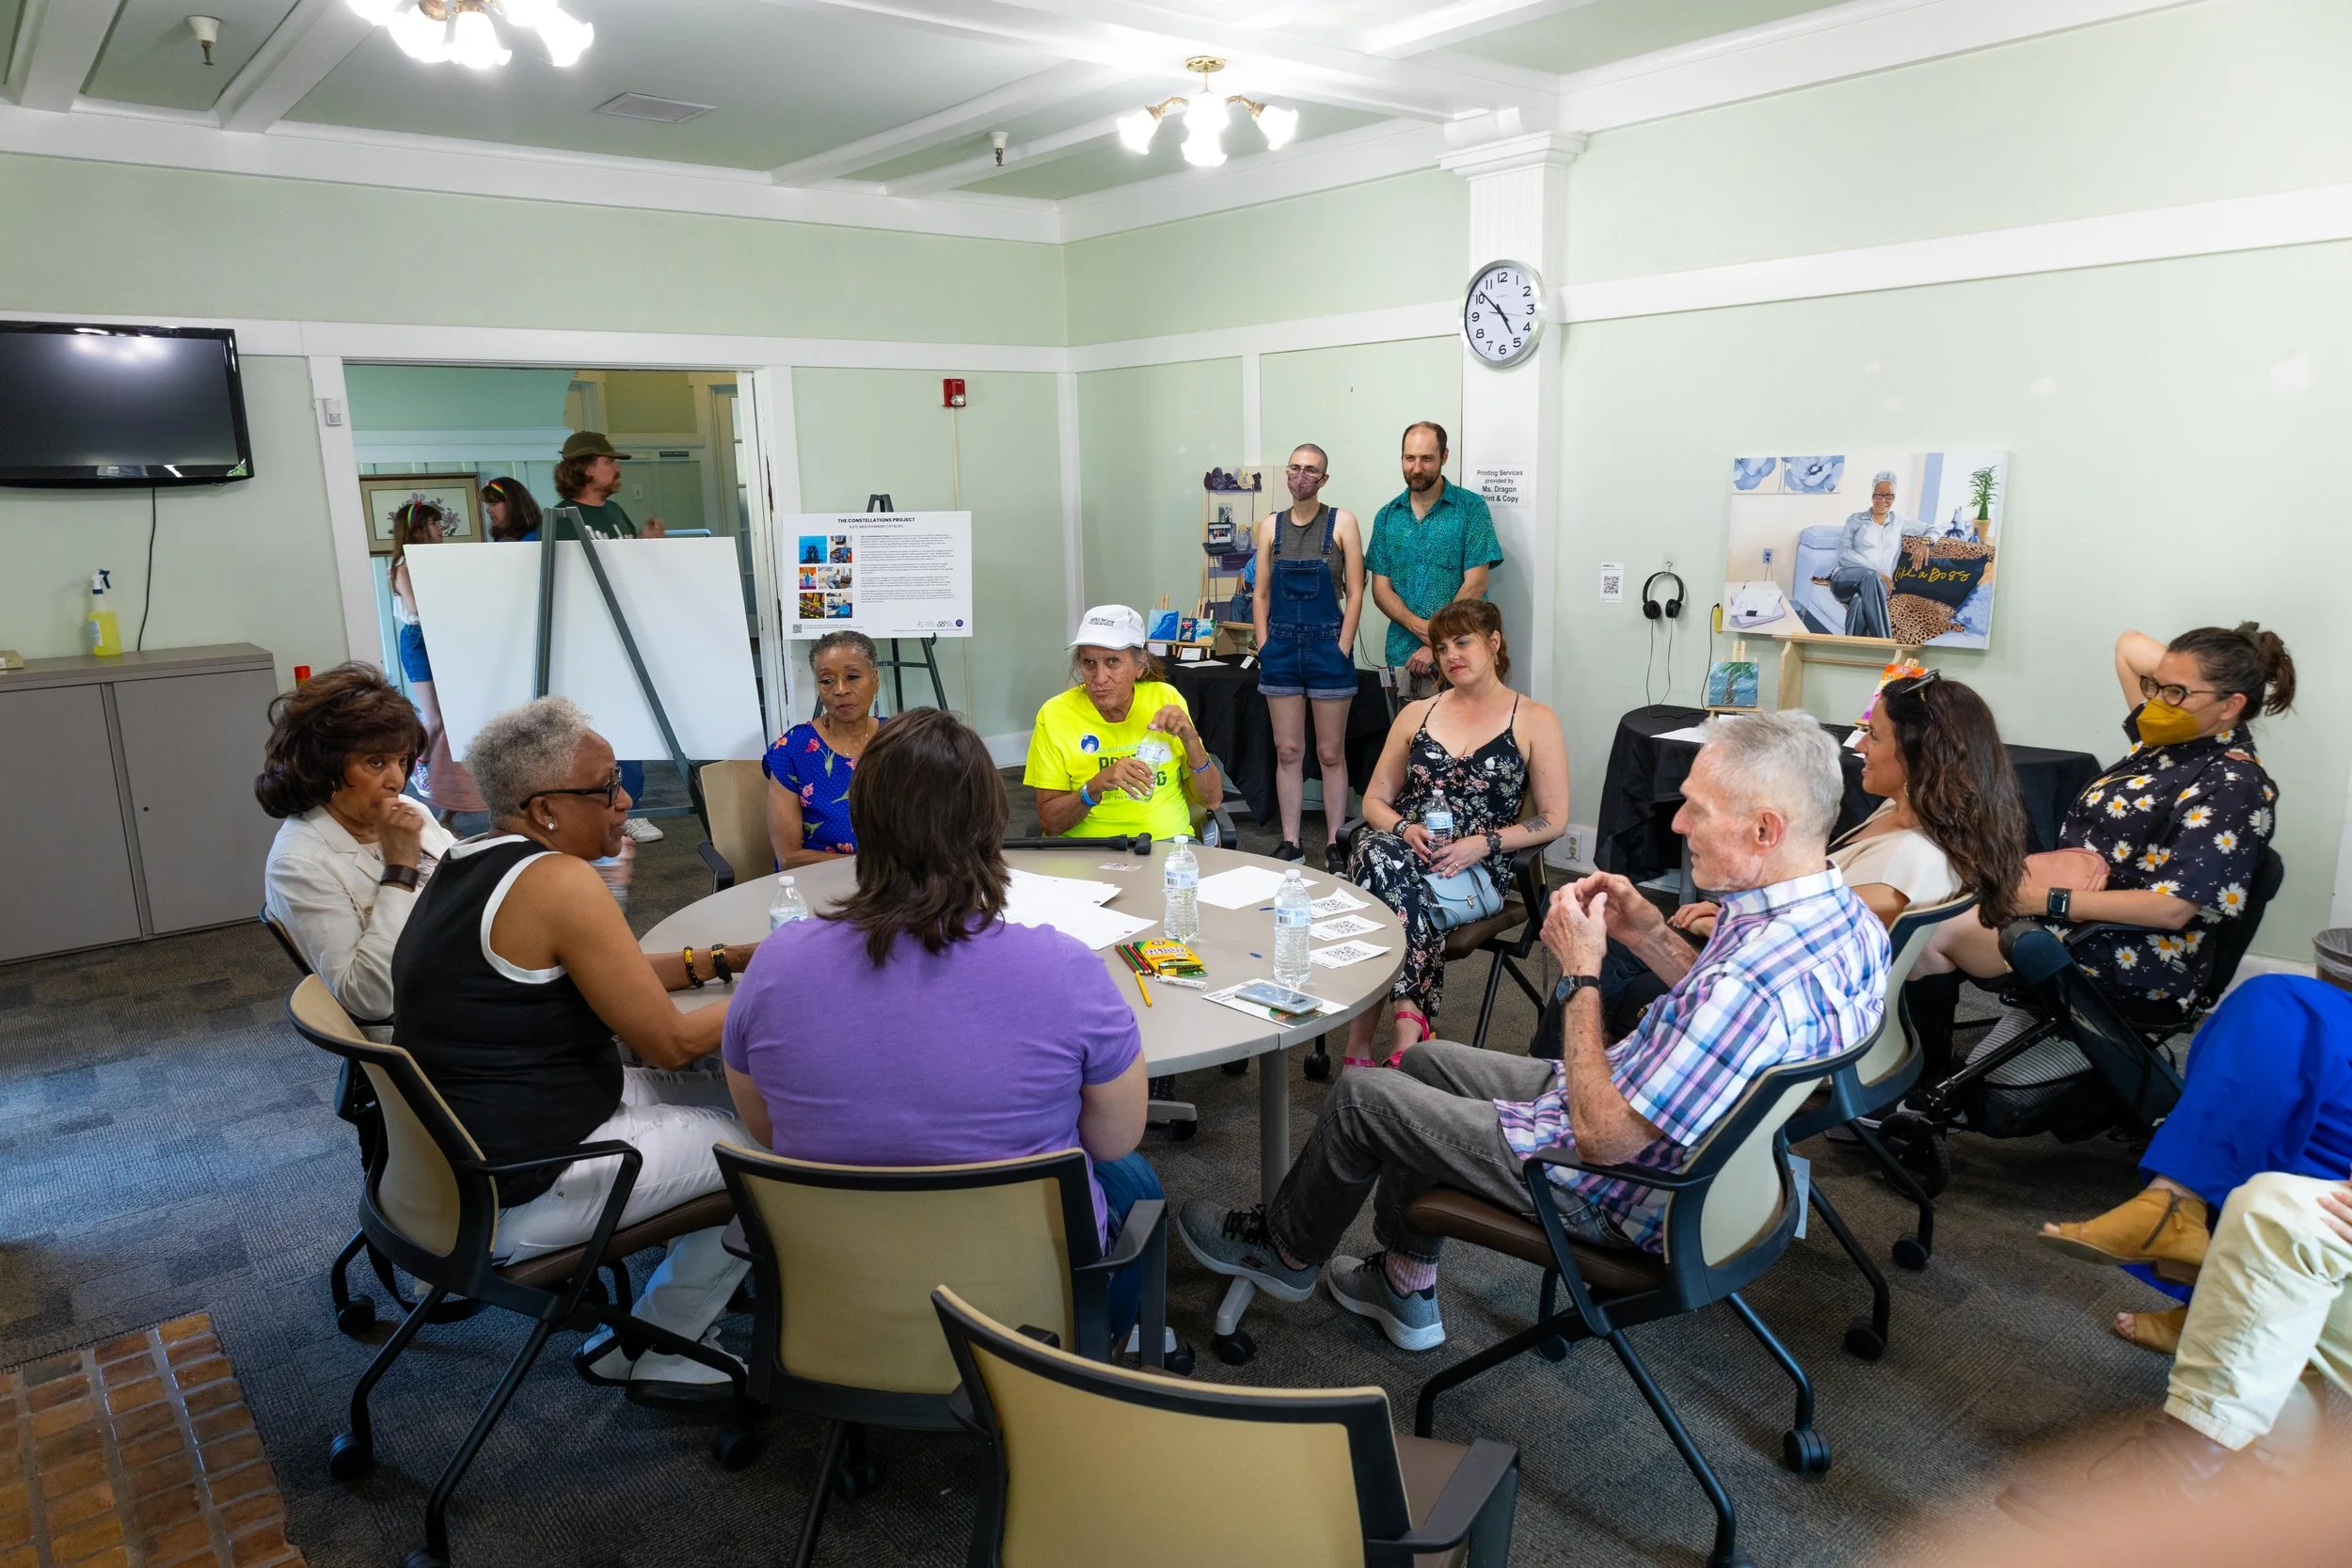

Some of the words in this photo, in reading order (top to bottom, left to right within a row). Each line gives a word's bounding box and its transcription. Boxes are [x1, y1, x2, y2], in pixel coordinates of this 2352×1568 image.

[1497, 272, 1508, 283] 12
[1486, 278, 1493, 291] 11
[1523, 285, 1531, 296] 2
[1475, 293, 1486, 305] 10
[1526, 304, 1535, 315] 3
[1471, 311, 1480, 323] 9
[1523, 322, 1531, 332] 4
[1476, 328, 1485, 339] 8
[1486, 341, 1493, 351] 7
[1513, 337, 1521, 348] 5
[1498, 344, 1507, 355] 6
[1494, 485, 1517, 494] Dragon
[1502, 495, 1518, 503] Copy
